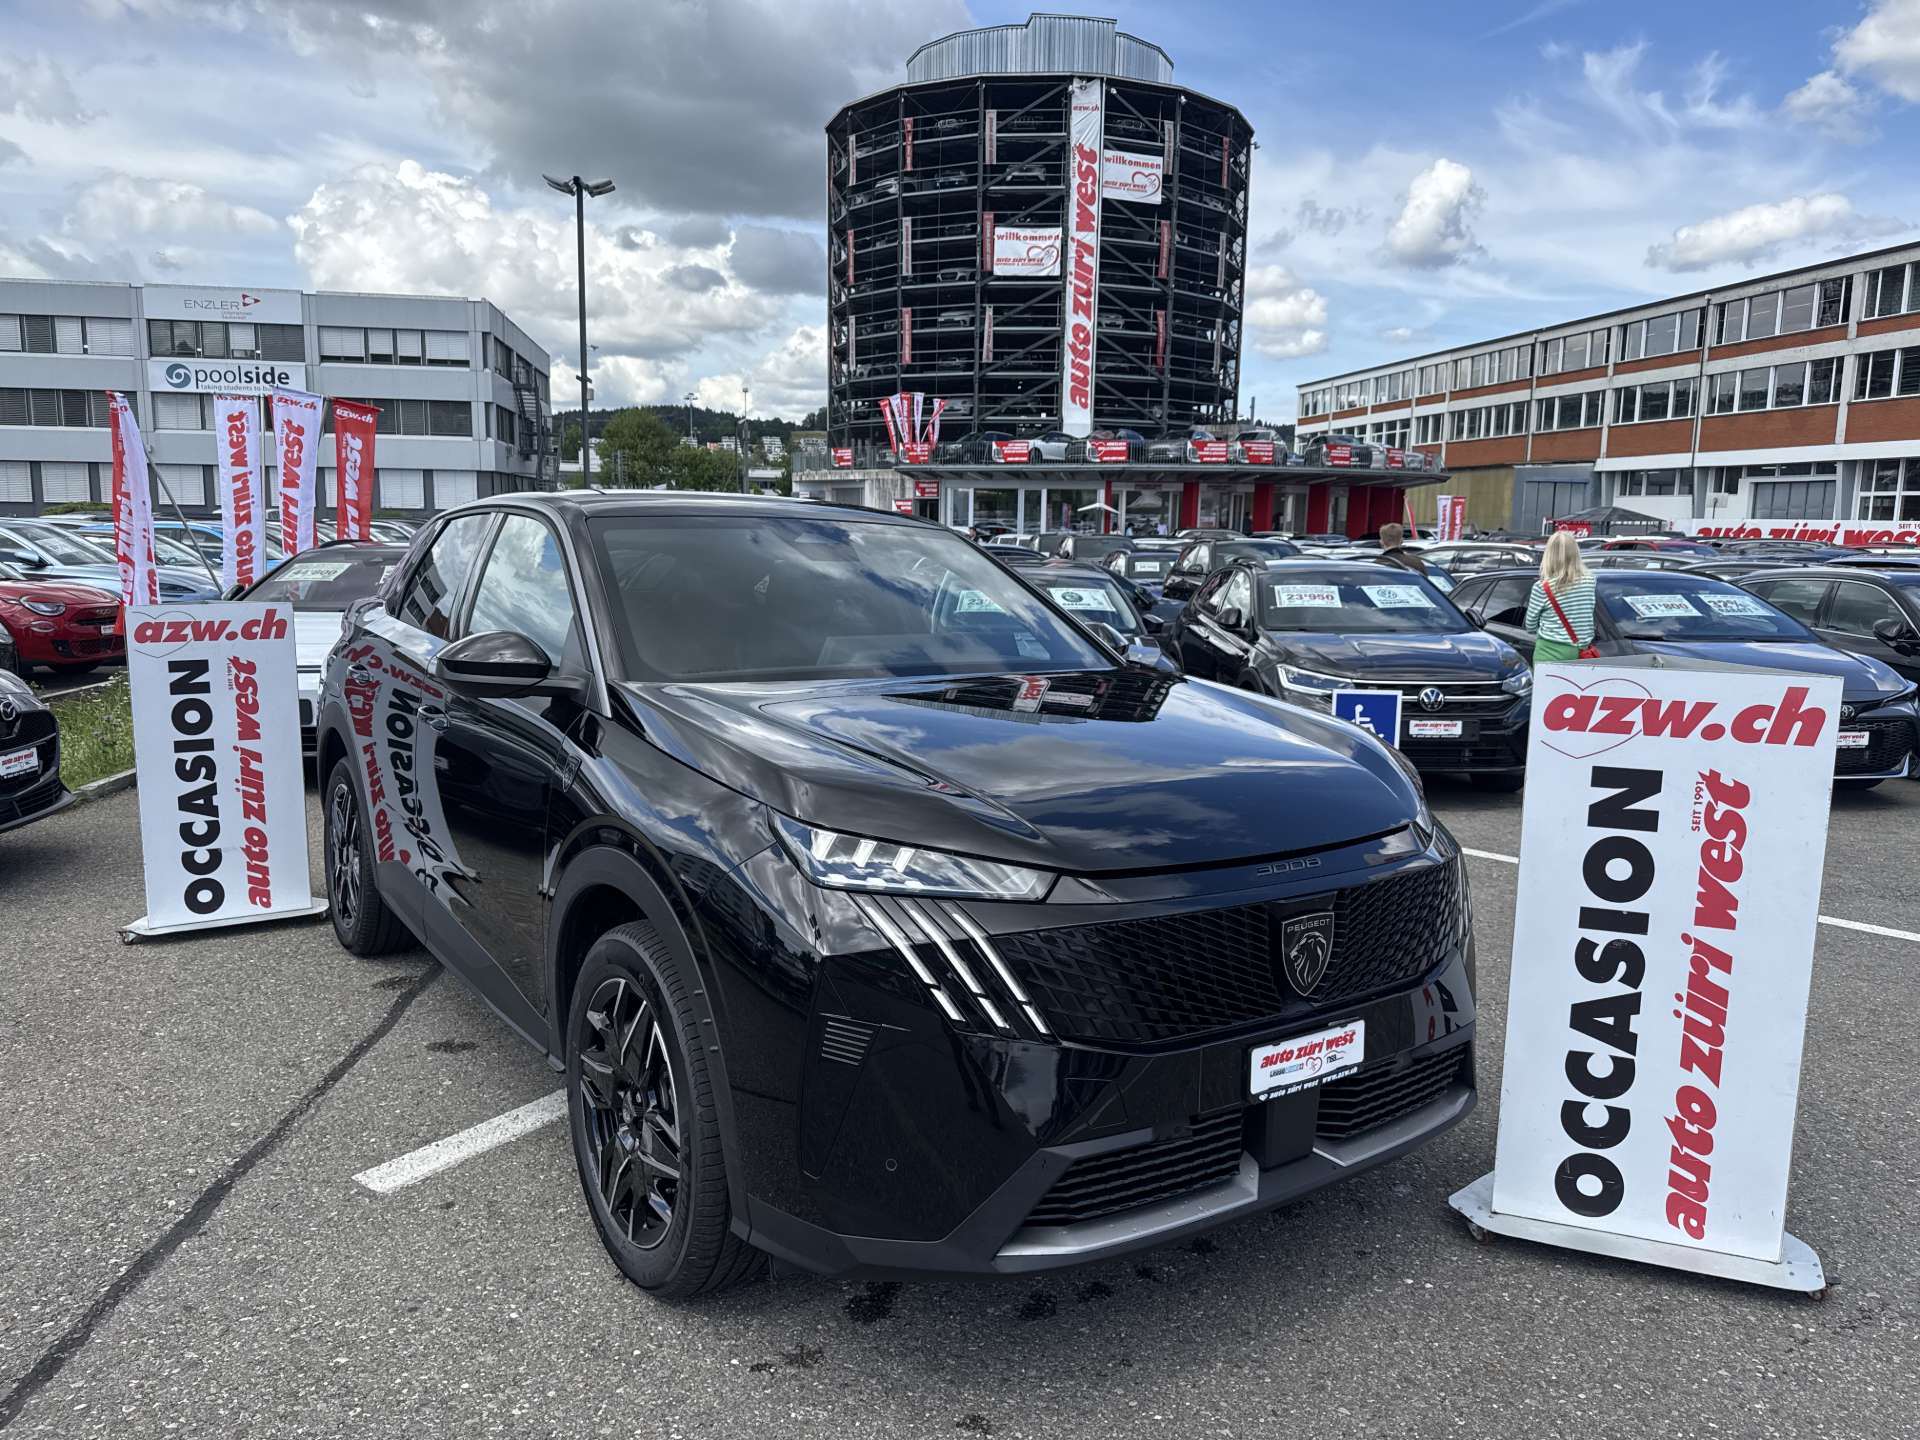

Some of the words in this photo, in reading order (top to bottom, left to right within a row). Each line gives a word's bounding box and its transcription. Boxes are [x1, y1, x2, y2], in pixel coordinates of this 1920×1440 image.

[1075, 142, 1098, 233] west
[1104, 155, 1161, 169] willkommen
[996, 231, 1060, 241] willkommen
[184, 300, 240, 311] ENZLER
[1068, 236, 1095, 322] züri
[194, 365, 290, 389] poolside
[1068, 323, 1092, 410] auto
[282, 417, 305, 489] west
[343, 431, 363, 500] west
[134, 608, 288, 644] azw.ch
[227, 655, 261, 741] west
[1542, 687, 1827, 747] azw.ch
[168, 659, 225, 915] OCCASION
[232, 745, 267, 825] züri
[1693, 781, 1705, 806] 1991
[1691, 811, 1702, 832] SEIT
[1694, 768, 1751, 931] west
[240, 826, 272, 909] auto
[1256, 857, 1322, 876] 3008
[1287, 918, 1331, 933] PEUGEOT
[1554, 764, 1664, 1218] OCCASION
[1672, 932, 1734, 1089] züri
[1260, 1048, 1295, 1069] auto
[1294, 1037, 1326, 1060] züri
[1326, 1029, 1356, 1051] west
[1269, 1089, 1286, 1099] auto
[1287, 1083, 1303, 1094] züri
[1303, 1079, 1320, 1090] west
[1663, 1084, 1719, 1241] auto
